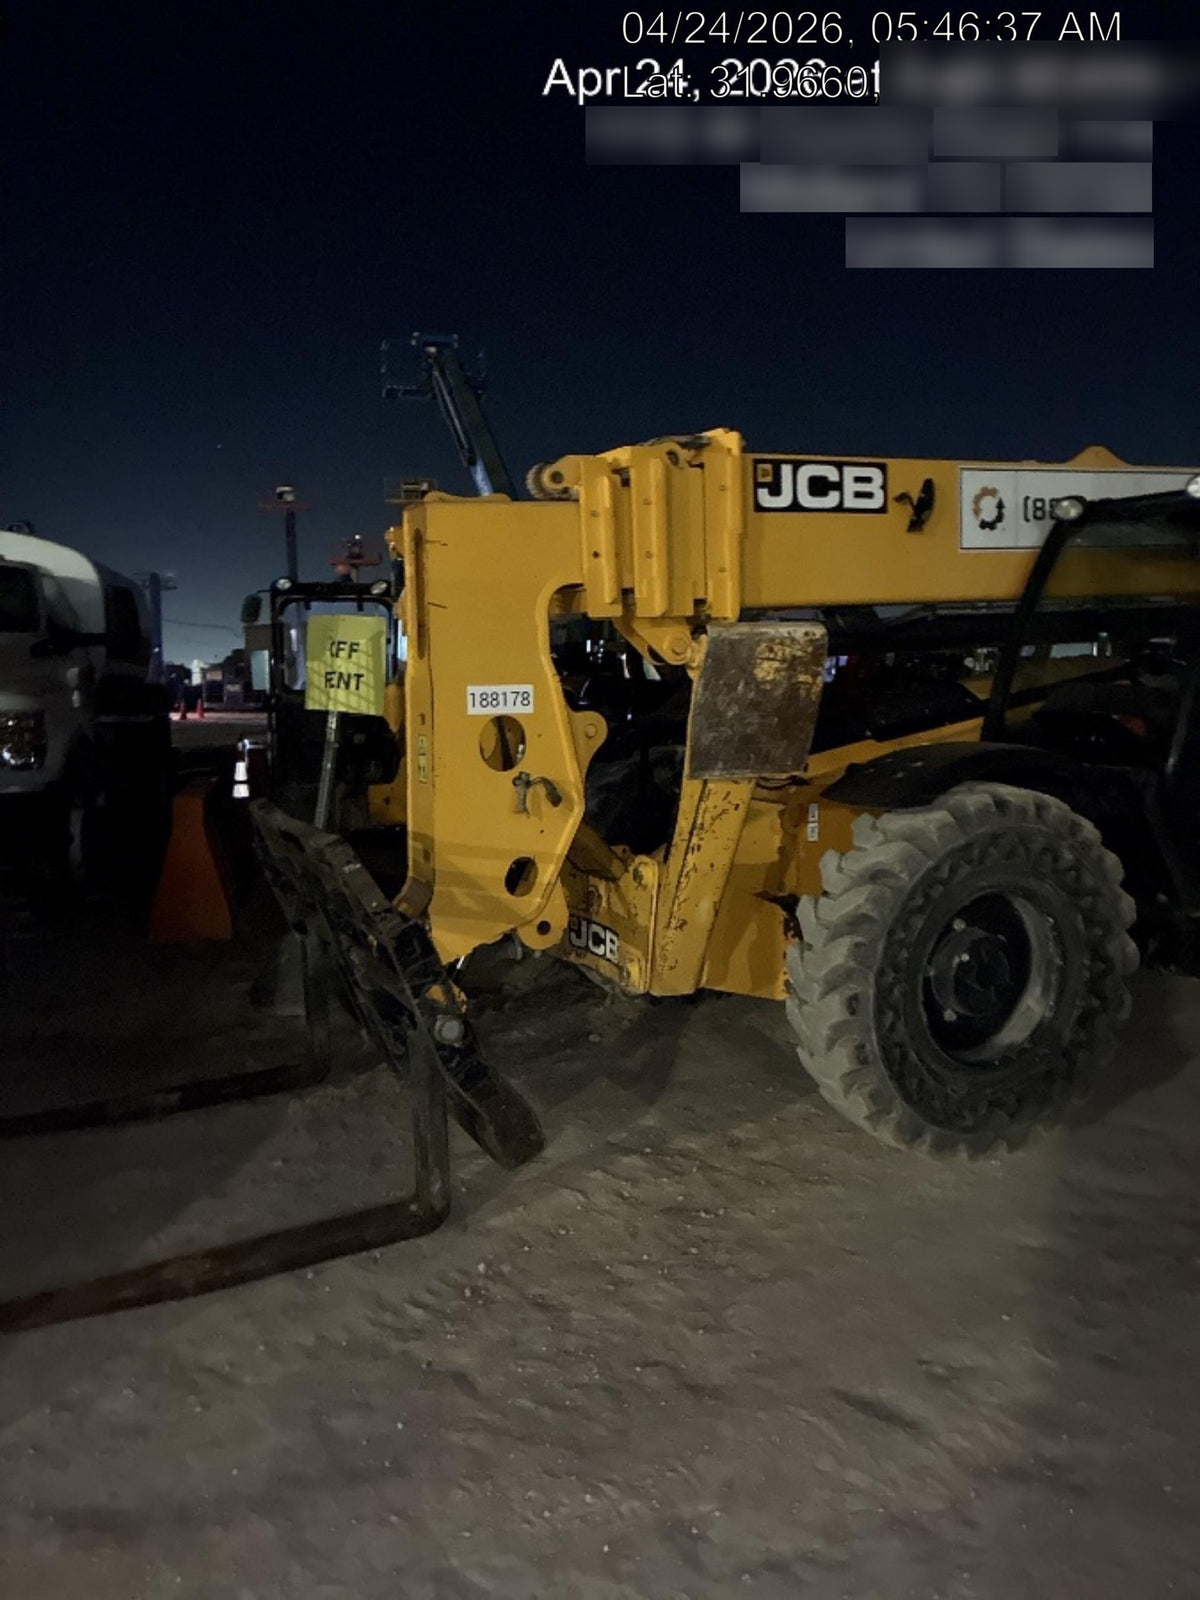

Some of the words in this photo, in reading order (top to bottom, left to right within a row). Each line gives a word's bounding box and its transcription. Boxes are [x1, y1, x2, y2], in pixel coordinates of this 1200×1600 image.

[757, 464, 884, 509] JCB
[469, 690, 531, 709] 188178
[570, 919, 619, 965] JCB
